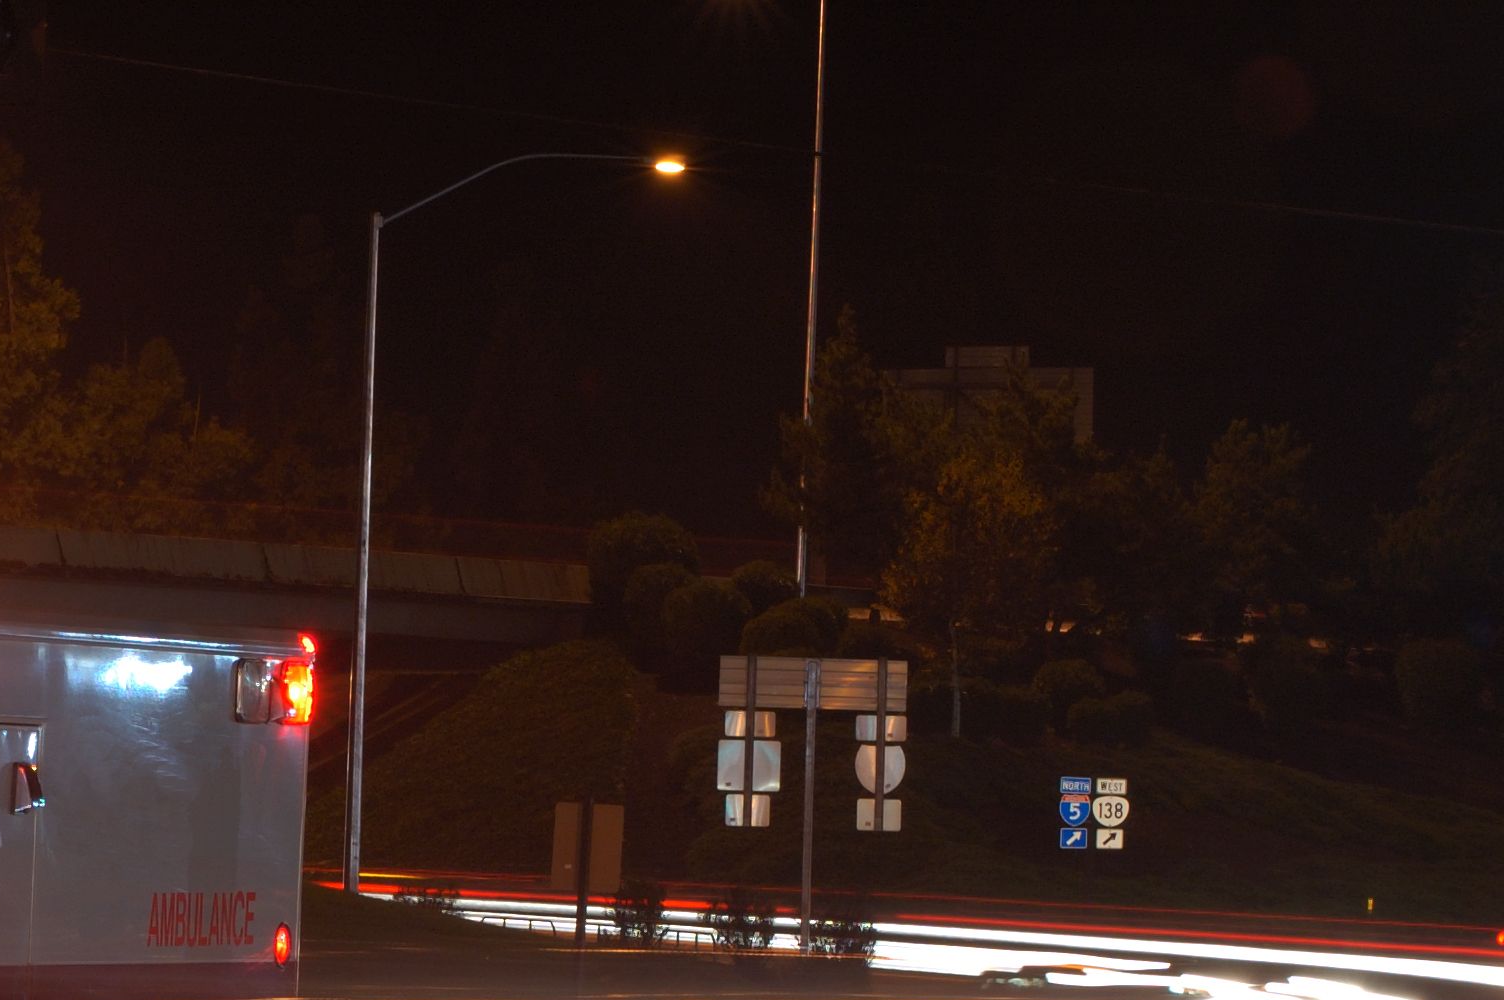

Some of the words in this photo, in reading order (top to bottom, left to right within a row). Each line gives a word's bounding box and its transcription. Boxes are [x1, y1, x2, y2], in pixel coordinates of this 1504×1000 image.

[1062, 781, 1090, 791] NORTH
[1100, 781, 1123, 792] WEST
[1069, 802, 1081, 820] 5
[1098, 802, 1123, 819] 138
[147, 891, 257, 948] AMBULANCE
